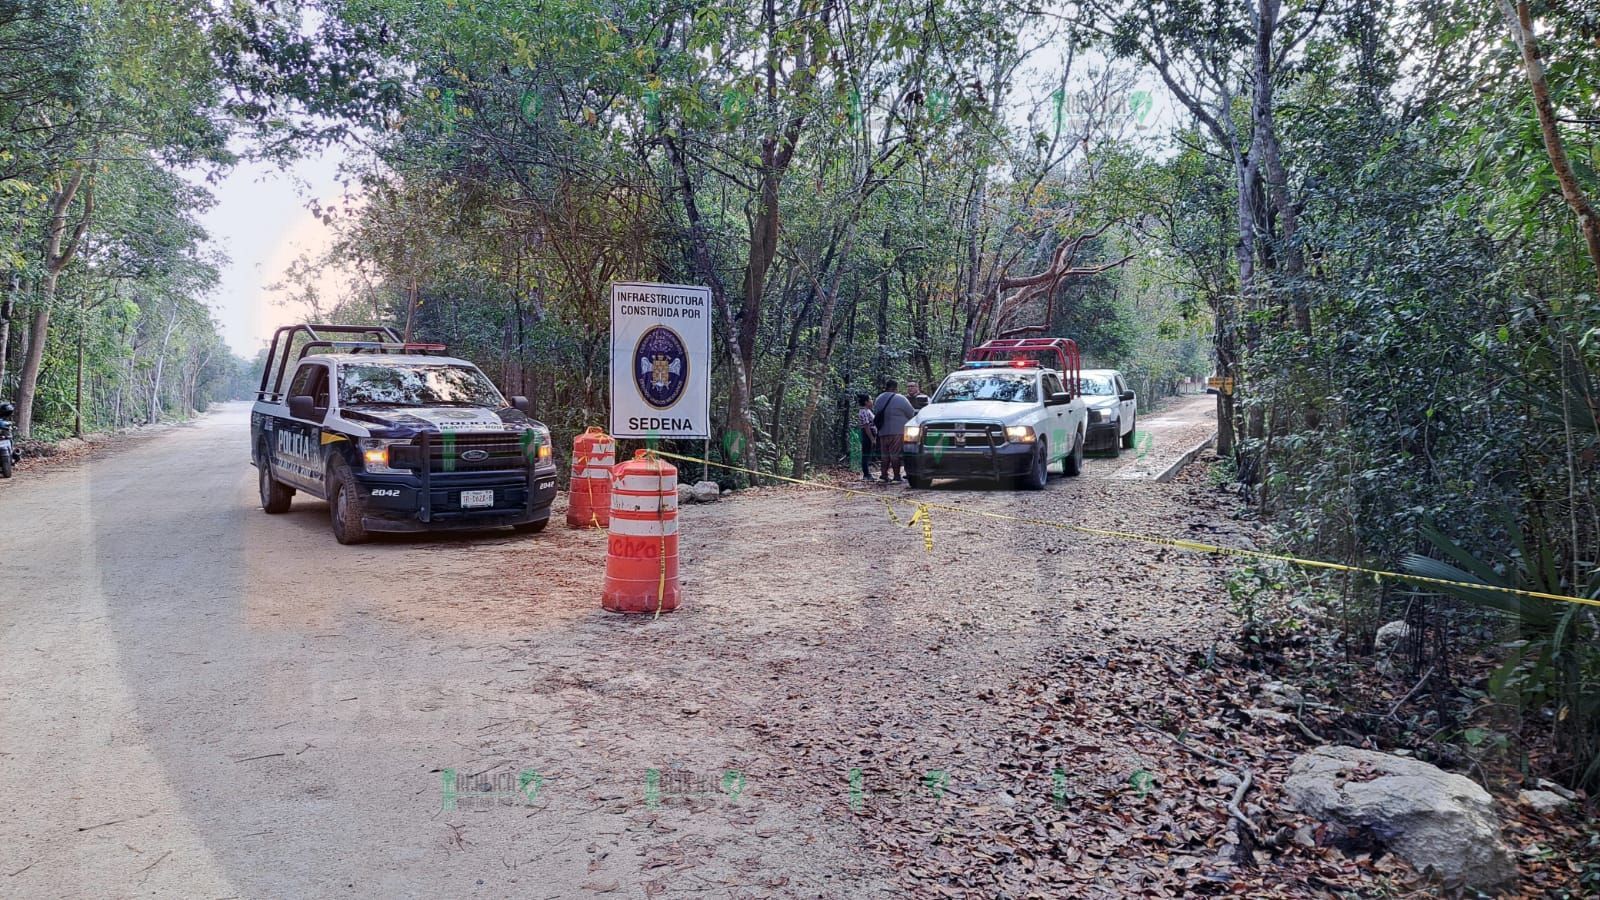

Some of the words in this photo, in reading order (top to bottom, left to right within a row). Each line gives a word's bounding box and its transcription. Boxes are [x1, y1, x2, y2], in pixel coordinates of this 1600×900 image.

[617, 291, 705, 307] INFRAESTRUCTURA
[620, 305, 680, 318] CONSTRUIDA
[681, 308, 701, 319] POR
[628, 417, 693, 431] SEDENA
[278, 428, 310, 461] POLICÍA
[539, 480, 555, 490] 2042
[371, 488, 401, 497] 2042
